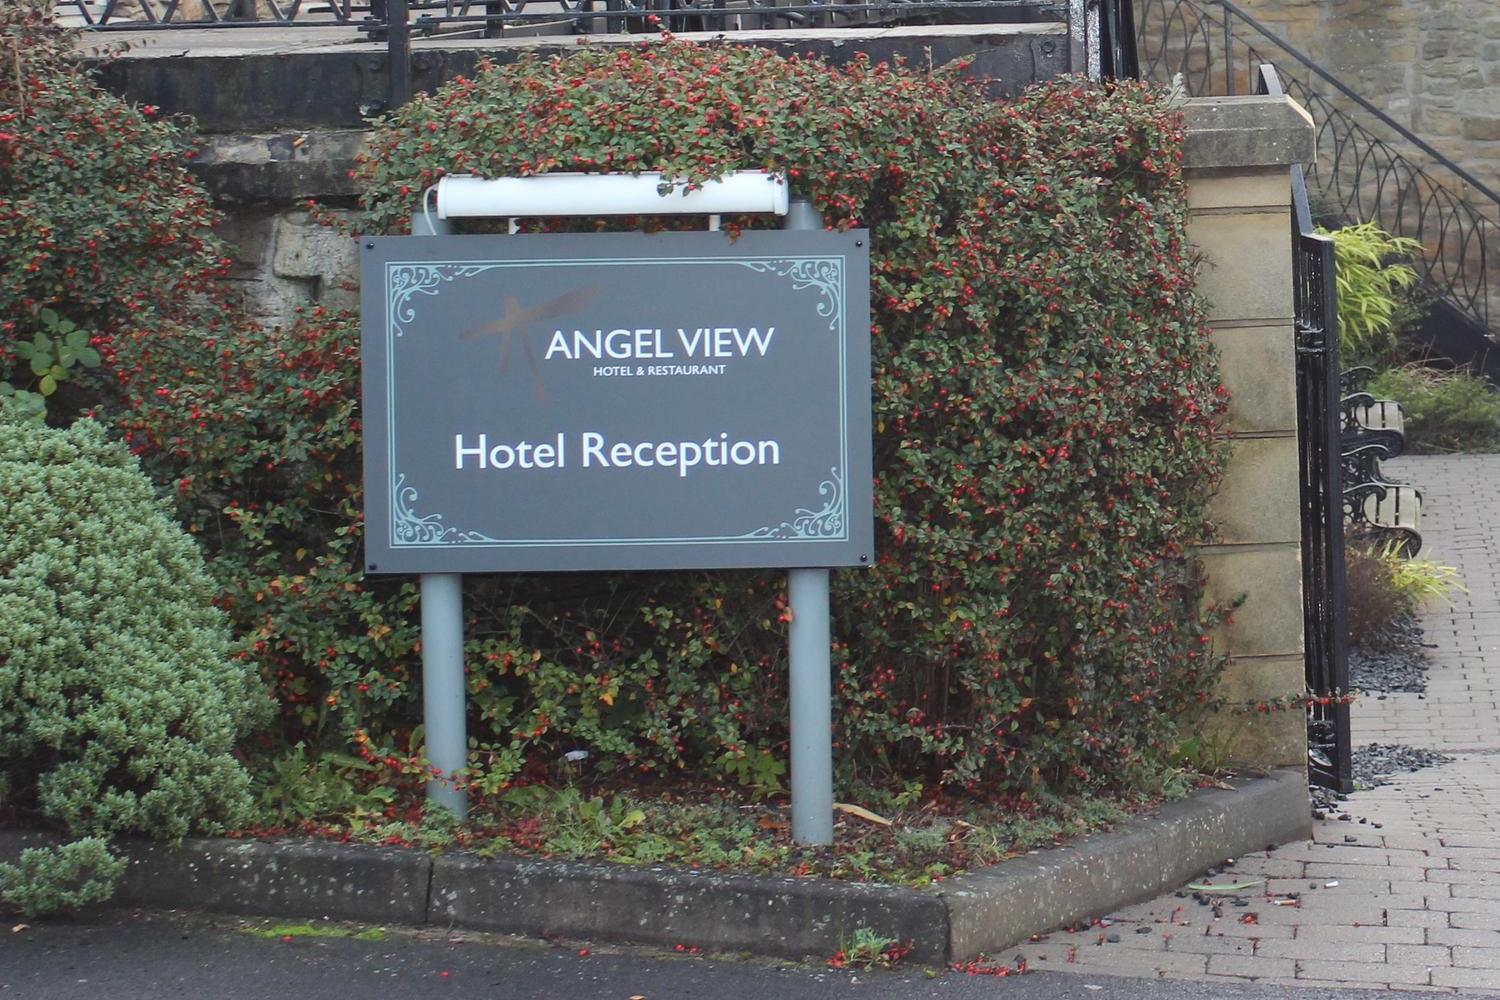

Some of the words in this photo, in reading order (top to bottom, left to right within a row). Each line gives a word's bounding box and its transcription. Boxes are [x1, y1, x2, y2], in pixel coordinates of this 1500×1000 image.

[544, 328, 674, 360] ANGEL
[676, 327, 776, 357] VIEW
[593, 366, 634, 377] HOTEL
[636, 366, 646, 376] &
[647, 364, 726, 376] RESTAURANT
[454, 432, 565, 470] Hotel
[581, 431, 780, 477] Reception
